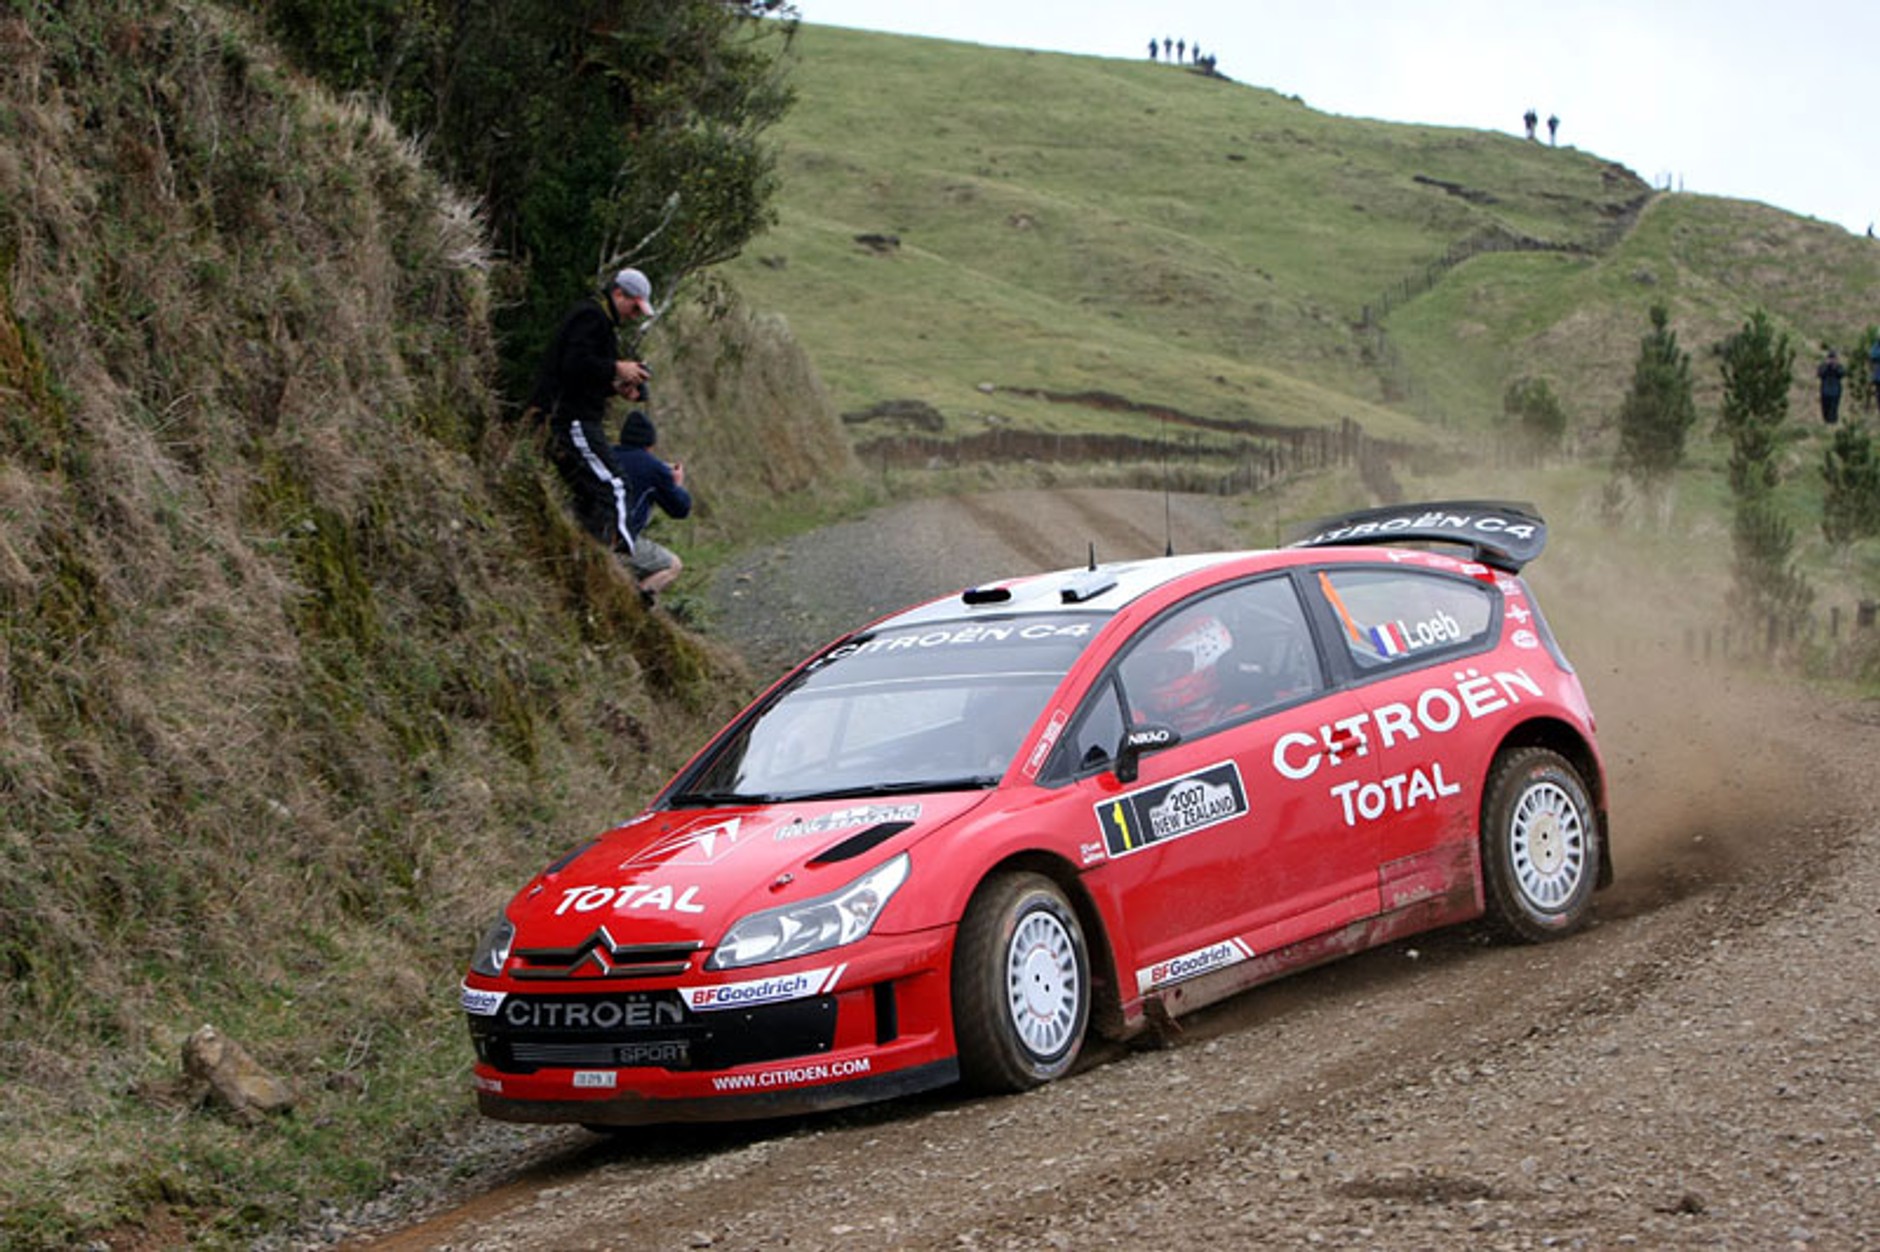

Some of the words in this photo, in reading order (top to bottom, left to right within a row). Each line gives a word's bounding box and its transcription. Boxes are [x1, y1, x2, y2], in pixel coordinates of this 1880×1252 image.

[1475, 517, 1536, 540] C4
[1020, 623, 1091, 638] C4
[1396, 608, 1461, 649] Loeb
[1273, 669, 1543, 779] CITROËN
[1171, 785, 1205, 811] 2007
[1330, 762, 1461, 826] TOTAL
[1113, 801, 1132, 850] 1
[1154, 813, 1181, 834] NEW
[1182, 796, 1233, 826] ZEALAND
[555, 884, 705, 915] TOTAL
[1151, 945, 1231, 982] BFGoodrich
[693, 976, 808, 1005] BFGoodrich
[505, 995, 684, 1027] CITROËN
[620, 1045, 689, 1063] SPORT
[712, 1058, 871, 1090] WWW.CITROEN.COM
